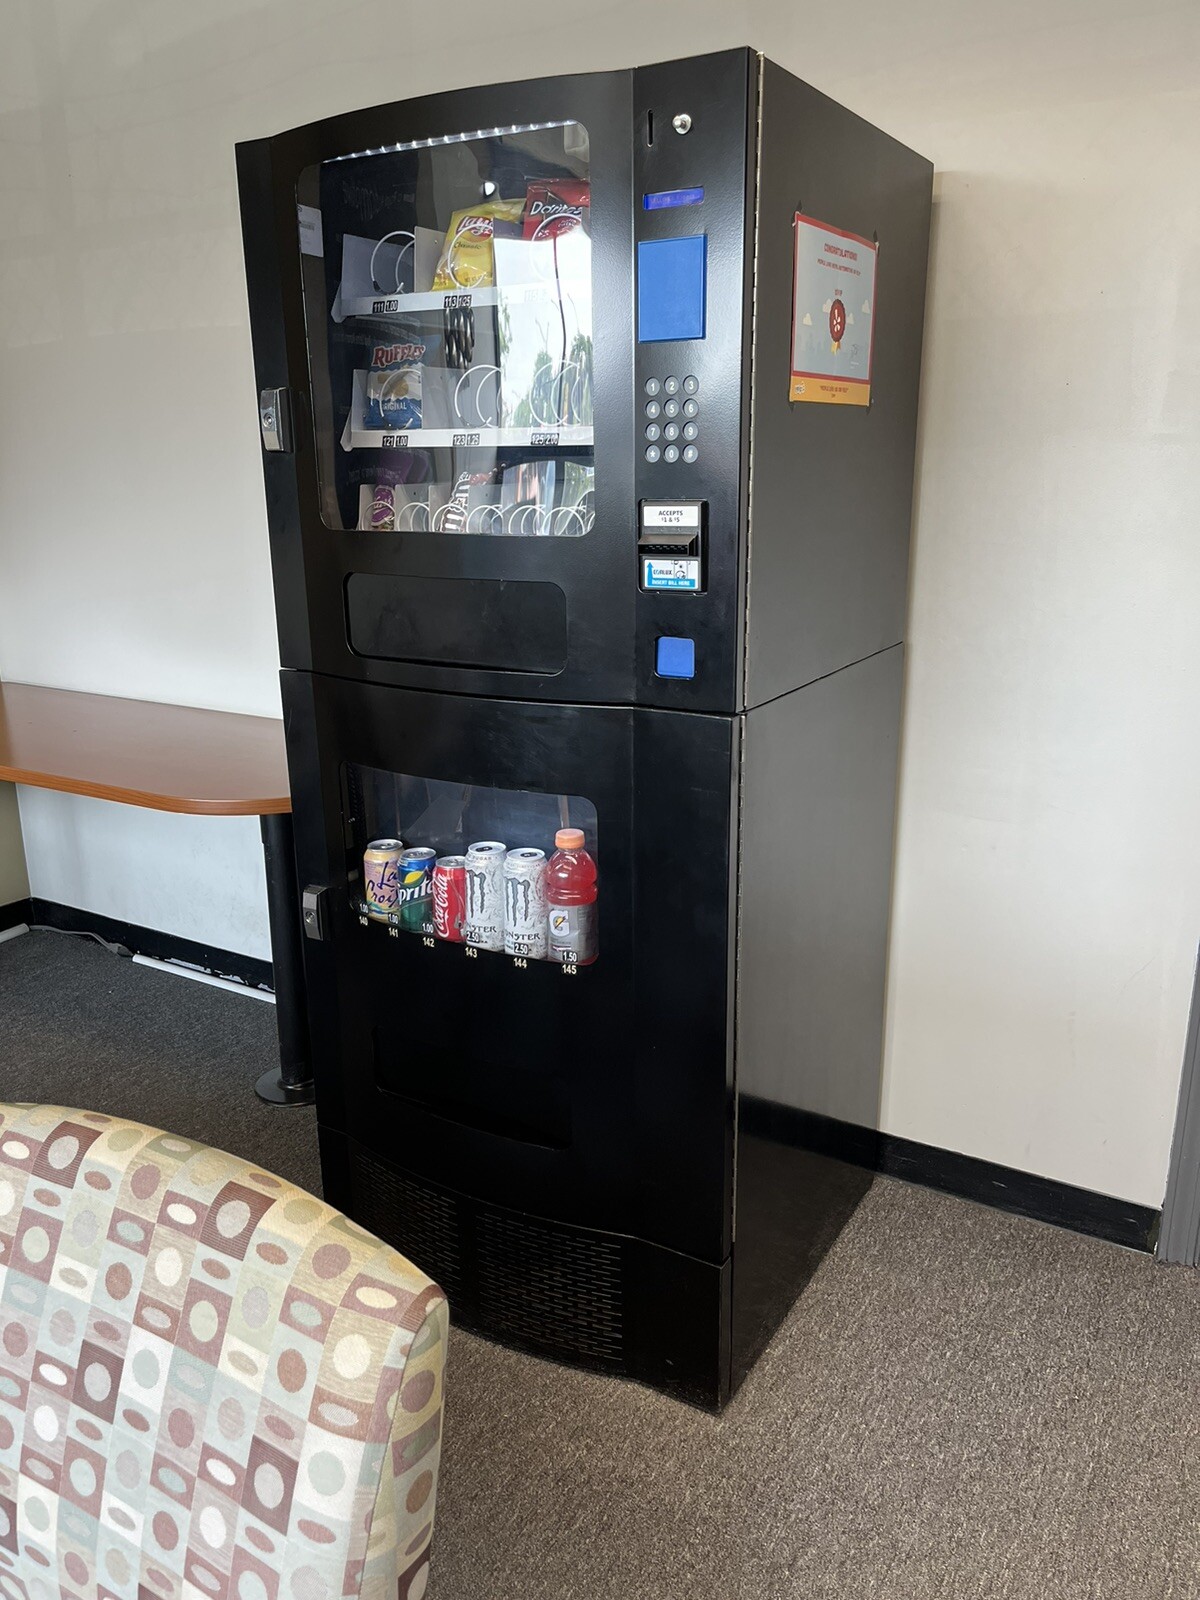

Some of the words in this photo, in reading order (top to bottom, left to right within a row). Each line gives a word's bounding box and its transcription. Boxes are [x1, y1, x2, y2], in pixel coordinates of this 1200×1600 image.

[373, 303, 384, 313] 111
[386, 300, 398, 312] 1.00
[371, 343, 426, 368] RUFFLES
[650, 382, 655, 392] 1
[669, 381, 675, 391] 2
[688, 380, 694, 390] 3
[650, 404, 656, 414] 4
[669, 404, 675, 413] 5
[688, 403, 694, 413] 6
[650, 427, 656, 436] 7
[669, 427, 675, 436] 8
[688, 426, 694, 436] 9
[383, 436, 394, 446] 121
[396, 436, 407, 446] 1.00
[453, 434, 465, 445] 123
[669, 449, 675, 458] 0
[388, 927, 399, 938] 141
[422, 923, 434, 934] 1.00
[422, 937, 435, 948] 142
[464, 947, 478, 958] 143
[514, 944, 528, 955] 2.50
[563, 951, 578, 963] 1.50
[513, 958, 528, 969] 144
[562, 964, 577, 975] 145
